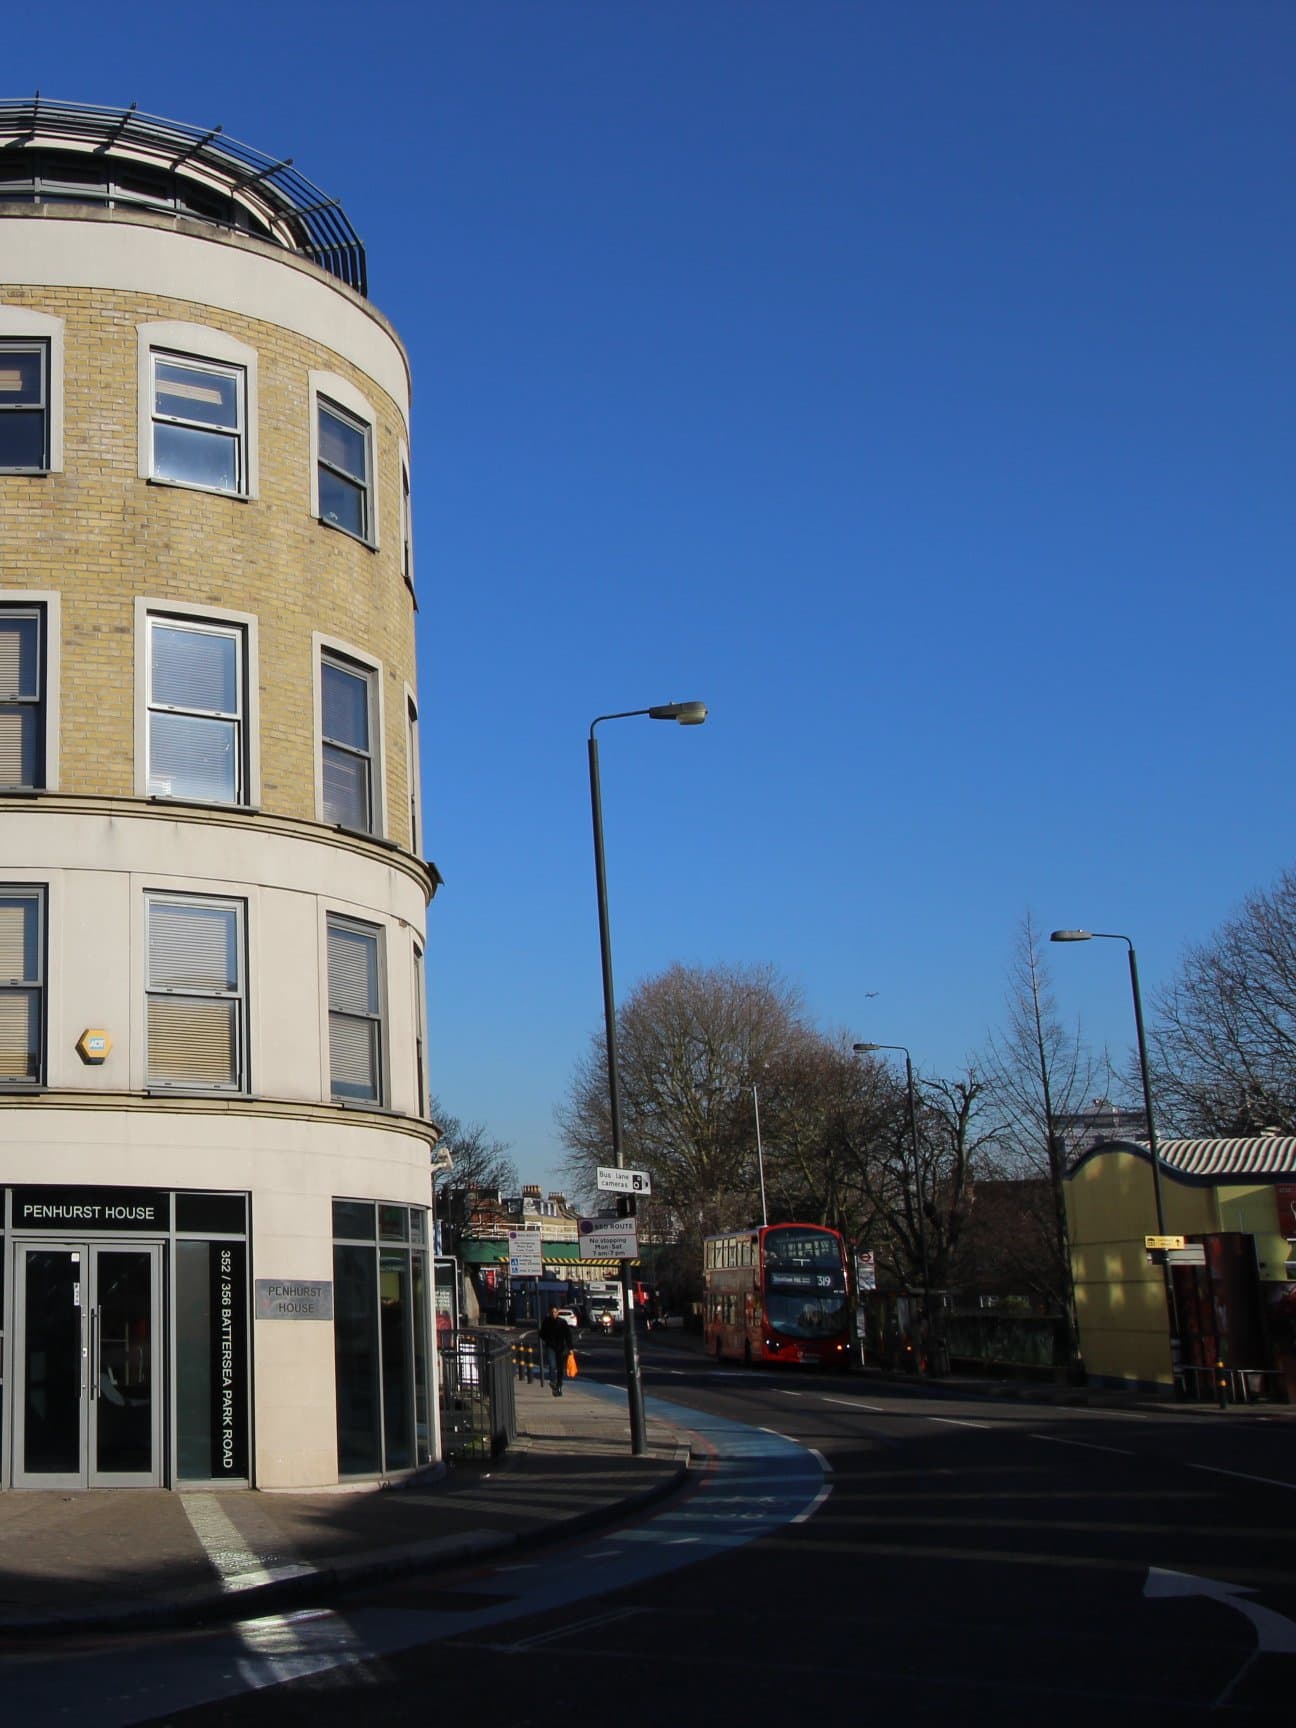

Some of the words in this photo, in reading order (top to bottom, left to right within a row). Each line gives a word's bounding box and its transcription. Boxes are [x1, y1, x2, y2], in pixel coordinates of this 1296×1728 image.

[600, 1171, 612, 1179] Bus
[23, 1205, 102, 1219] PENHURST
[105, 1206, 155, 1220] HOUSE
[221, 1250, 231, 1273] 352
[816, 1275, 831, 1287] 319
[221, 1283, 232, 1306] 356
[268, 1286, 322, 1297] PENHURST
[278, 1303, 315, 1313] HOUSE
[221, 1309, 233, 1387] BATTERSEA
[222, 1390, 233, 1426] PARK
[222, 1429, 233, 1469] ROAD
